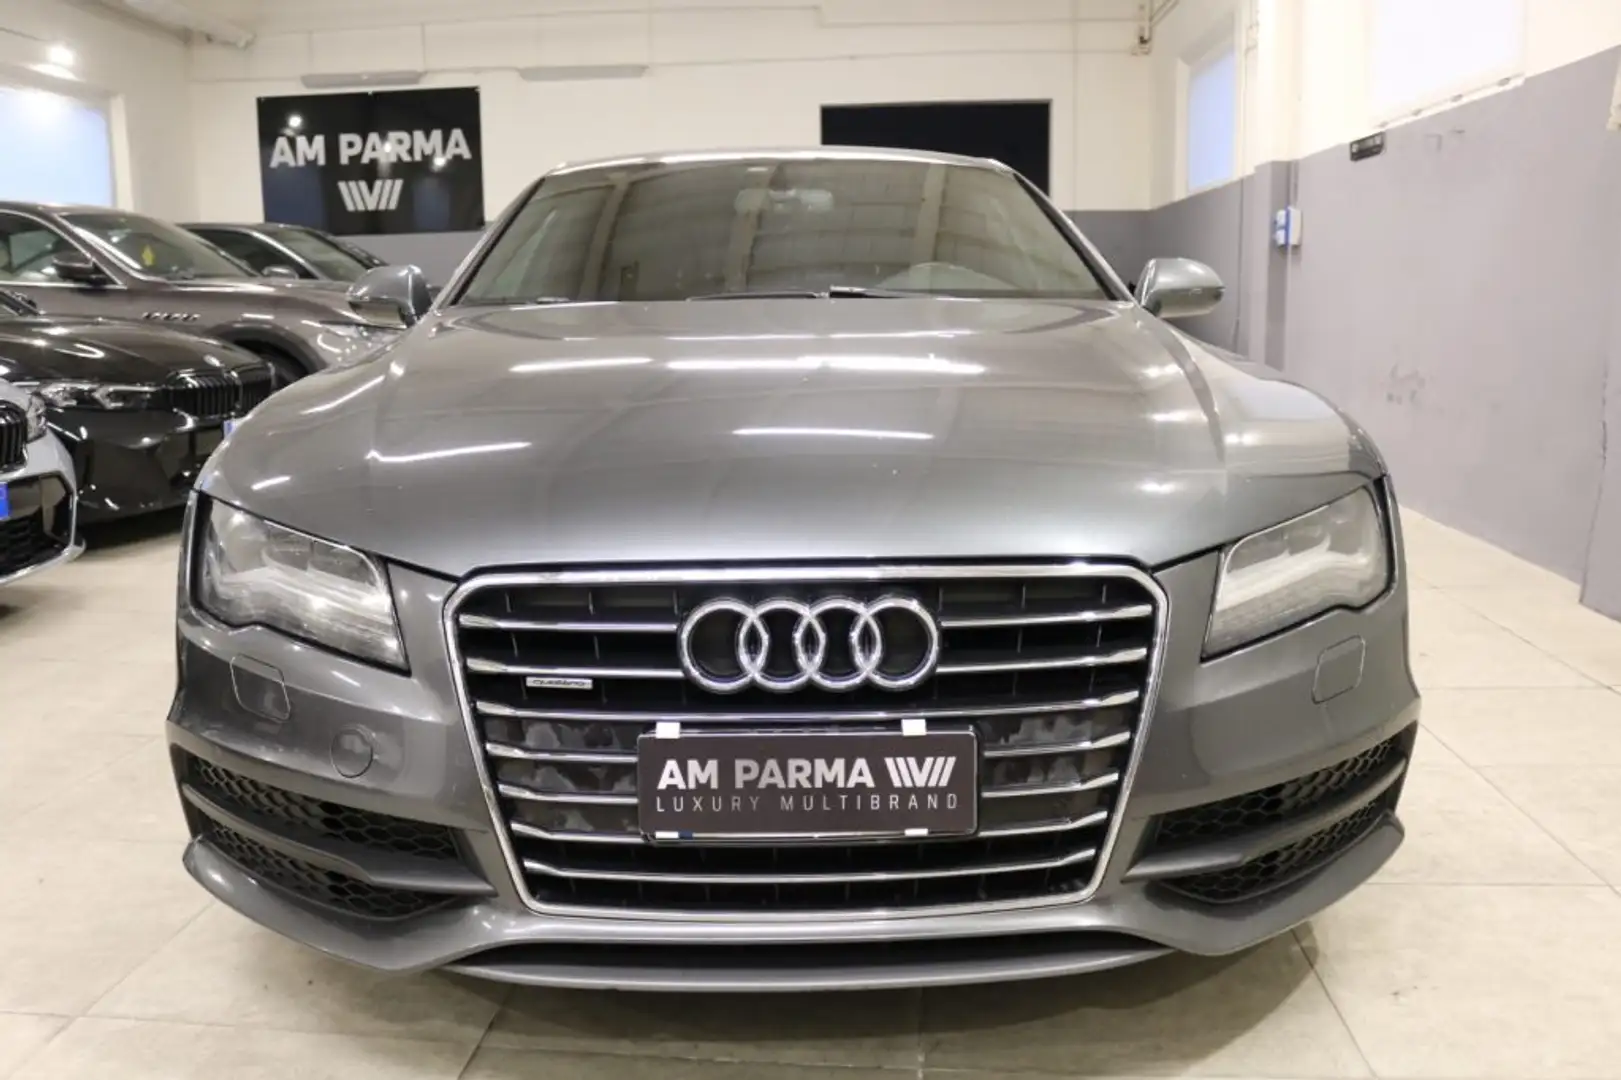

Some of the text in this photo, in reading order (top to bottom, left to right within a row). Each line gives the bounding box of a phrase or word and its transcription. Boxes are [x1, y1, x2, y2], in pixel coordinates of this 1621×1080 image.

[269, 128, 472, 168] AM PARMA
[657, 757, 876, 790] AM PARMA
[656, 793, 958, 812] LUXURY MULTIBRAND
